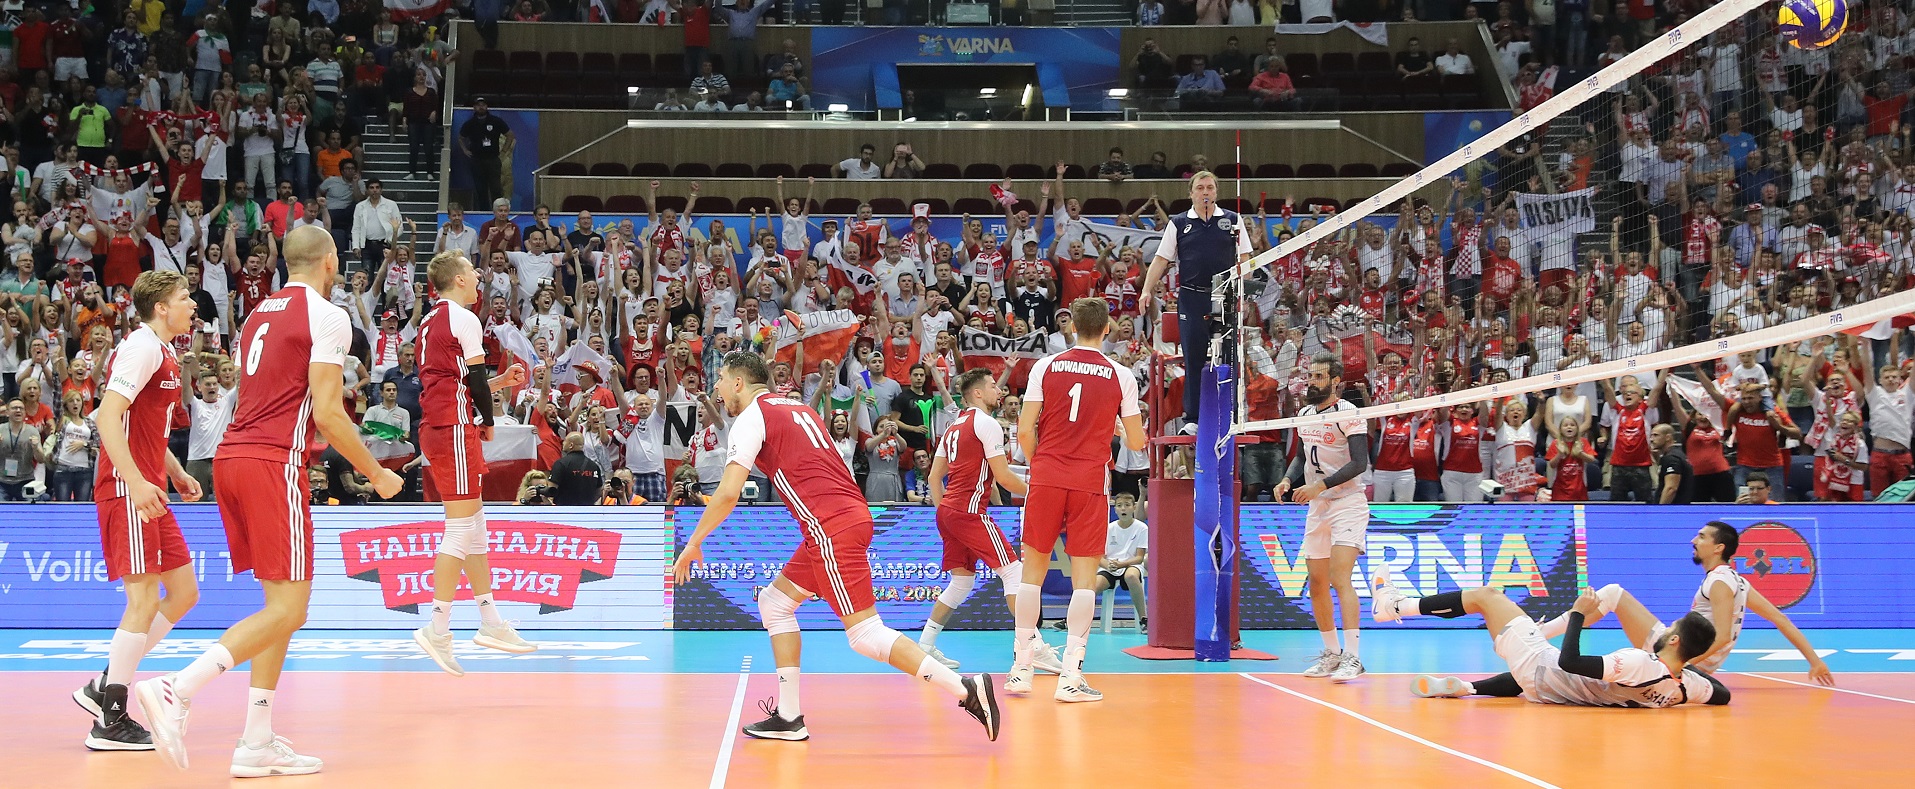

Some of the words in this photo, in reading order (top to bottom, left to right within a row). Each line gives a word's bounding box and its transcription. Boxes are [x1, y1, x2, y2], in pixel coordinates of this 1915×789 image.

[946, 37, 1014, 54] VARNA
[257, 296, 293, 313] KUREK
[246, 322, 270, 376] 6
[1051, 360, 1114, 380] NOWAKOWSKI
[1068, 382, 1082, 422] 1
[791, 410, 830, 449] 11
[1738, 416, 1771, 427] POLSKA
[945, 429, 960, 464] 13
[355, 530, 604, 564] НАЦНАЛНА
[396, 566, 563, 597] ЛОРИЯ
[1259, 533, 1549, 598] VRNA
[903, 585, 943, 602] 2018
